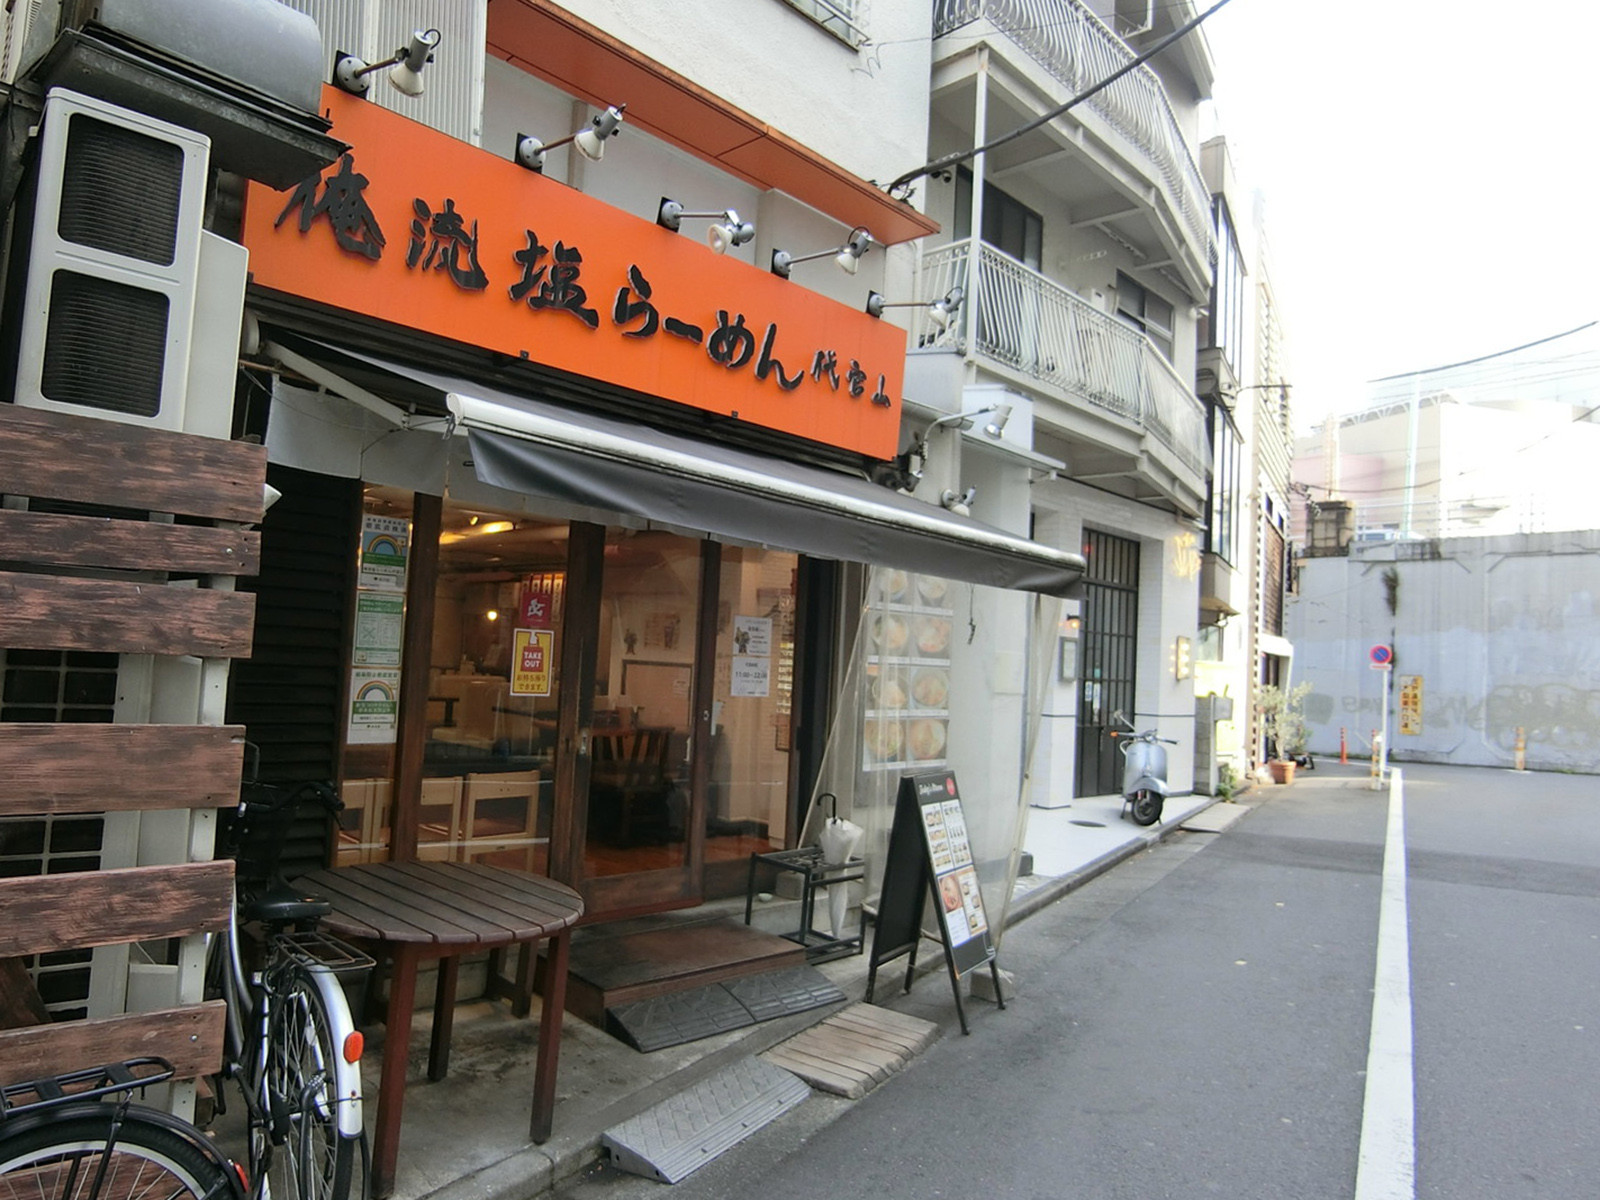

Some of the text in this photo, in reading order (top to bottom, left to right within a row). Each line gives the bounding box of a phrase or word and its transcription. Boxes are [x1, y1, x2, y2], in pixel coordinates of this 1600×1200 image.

[810, 350, 891, 409] 代官山
[523, 651, 542, 660] TAKE
[524, 660, 541, 668] OUT
